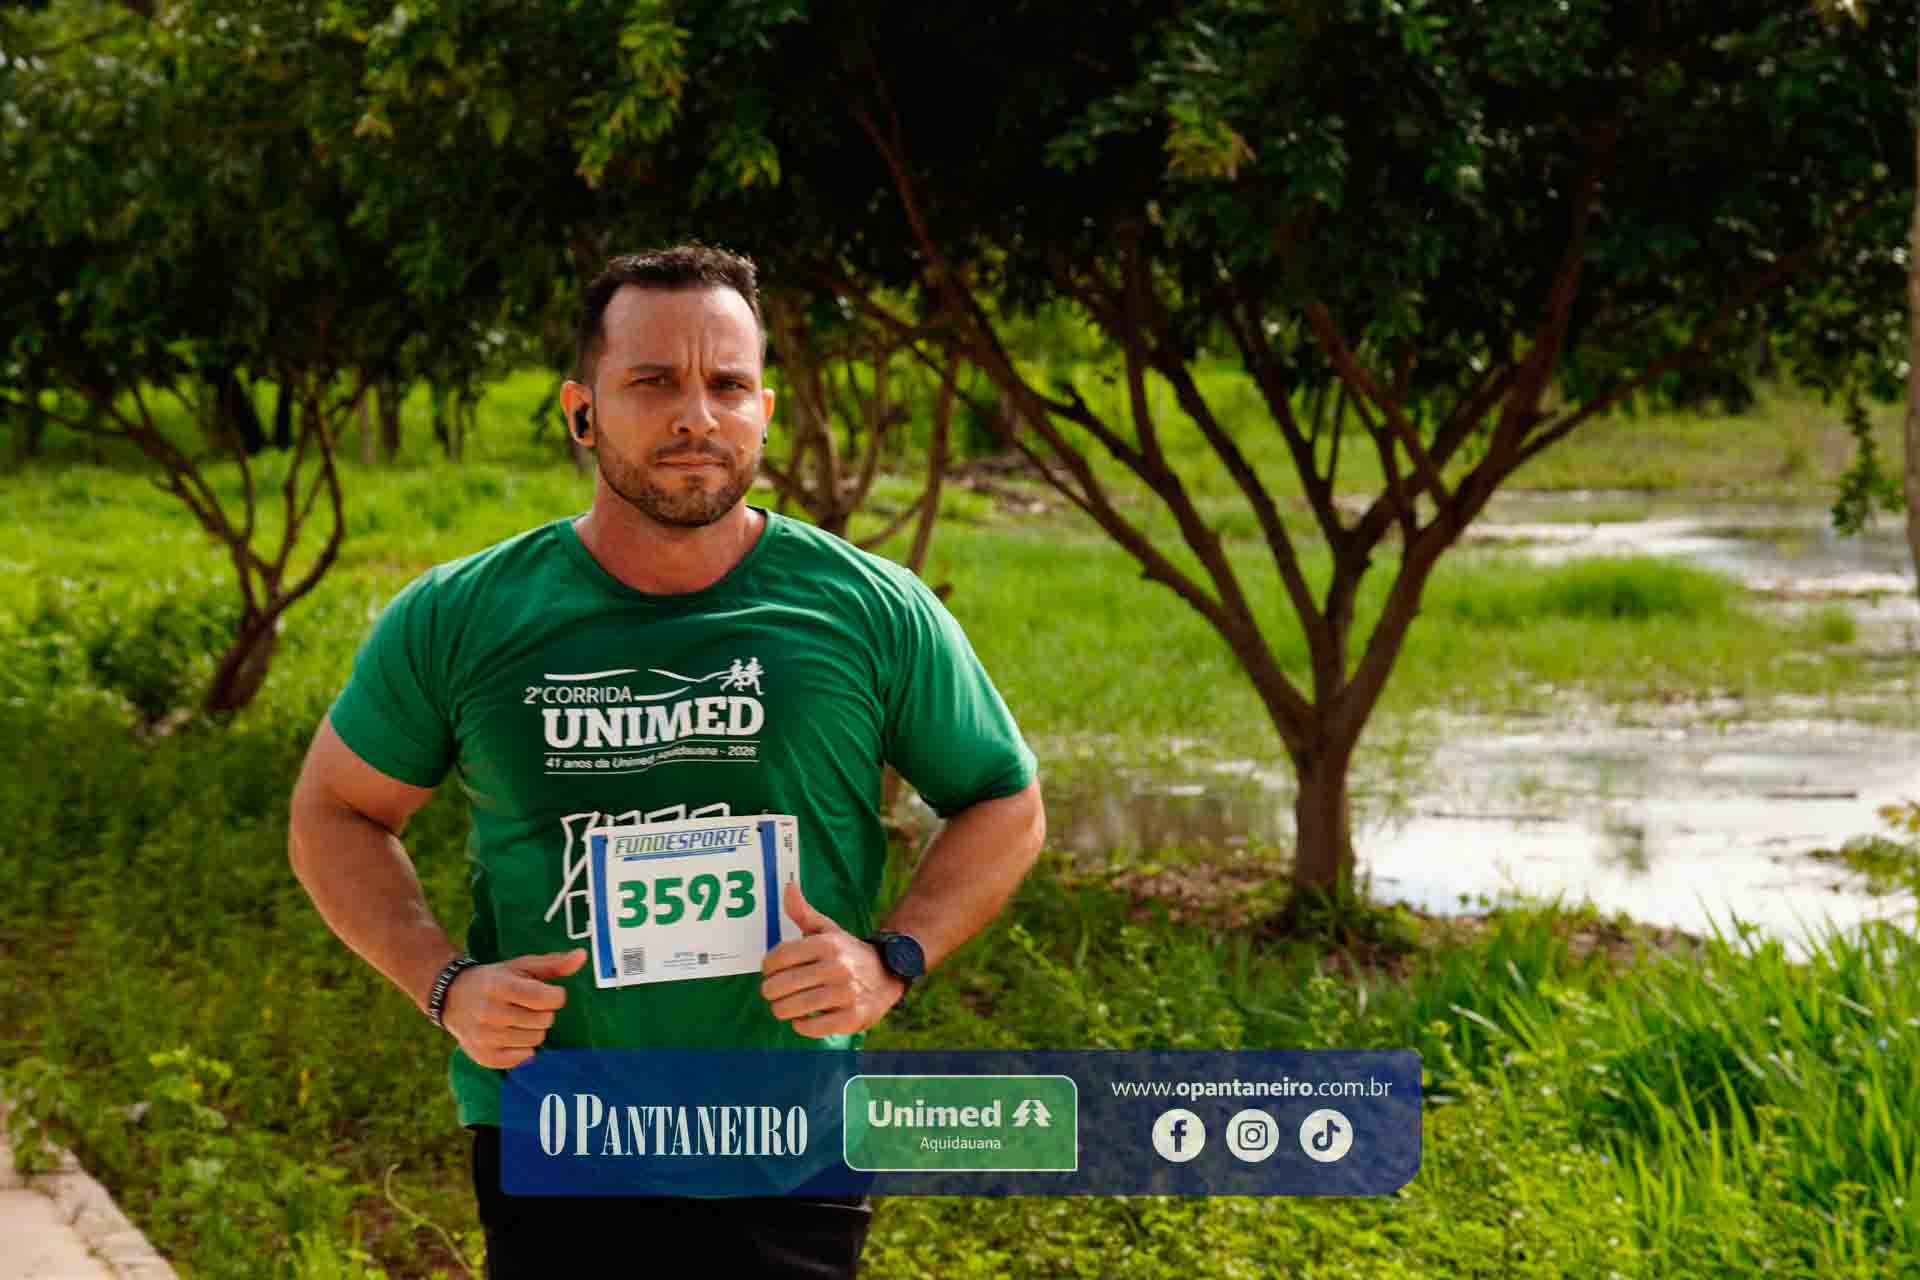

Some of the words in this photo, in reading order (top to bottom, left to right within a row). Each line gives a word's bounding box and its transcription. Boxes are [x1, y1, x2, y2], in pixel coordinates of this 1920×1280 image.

[542, 696, 765, 749] UNIMED
[544, 757, 561, 769] 41
[563, 760, 593, 769] anos
[611, 754, 656, 769] Unimed
[615, 829, 752, 855] FUNDESPORTE
[616, 870, 756, 928] 3593
